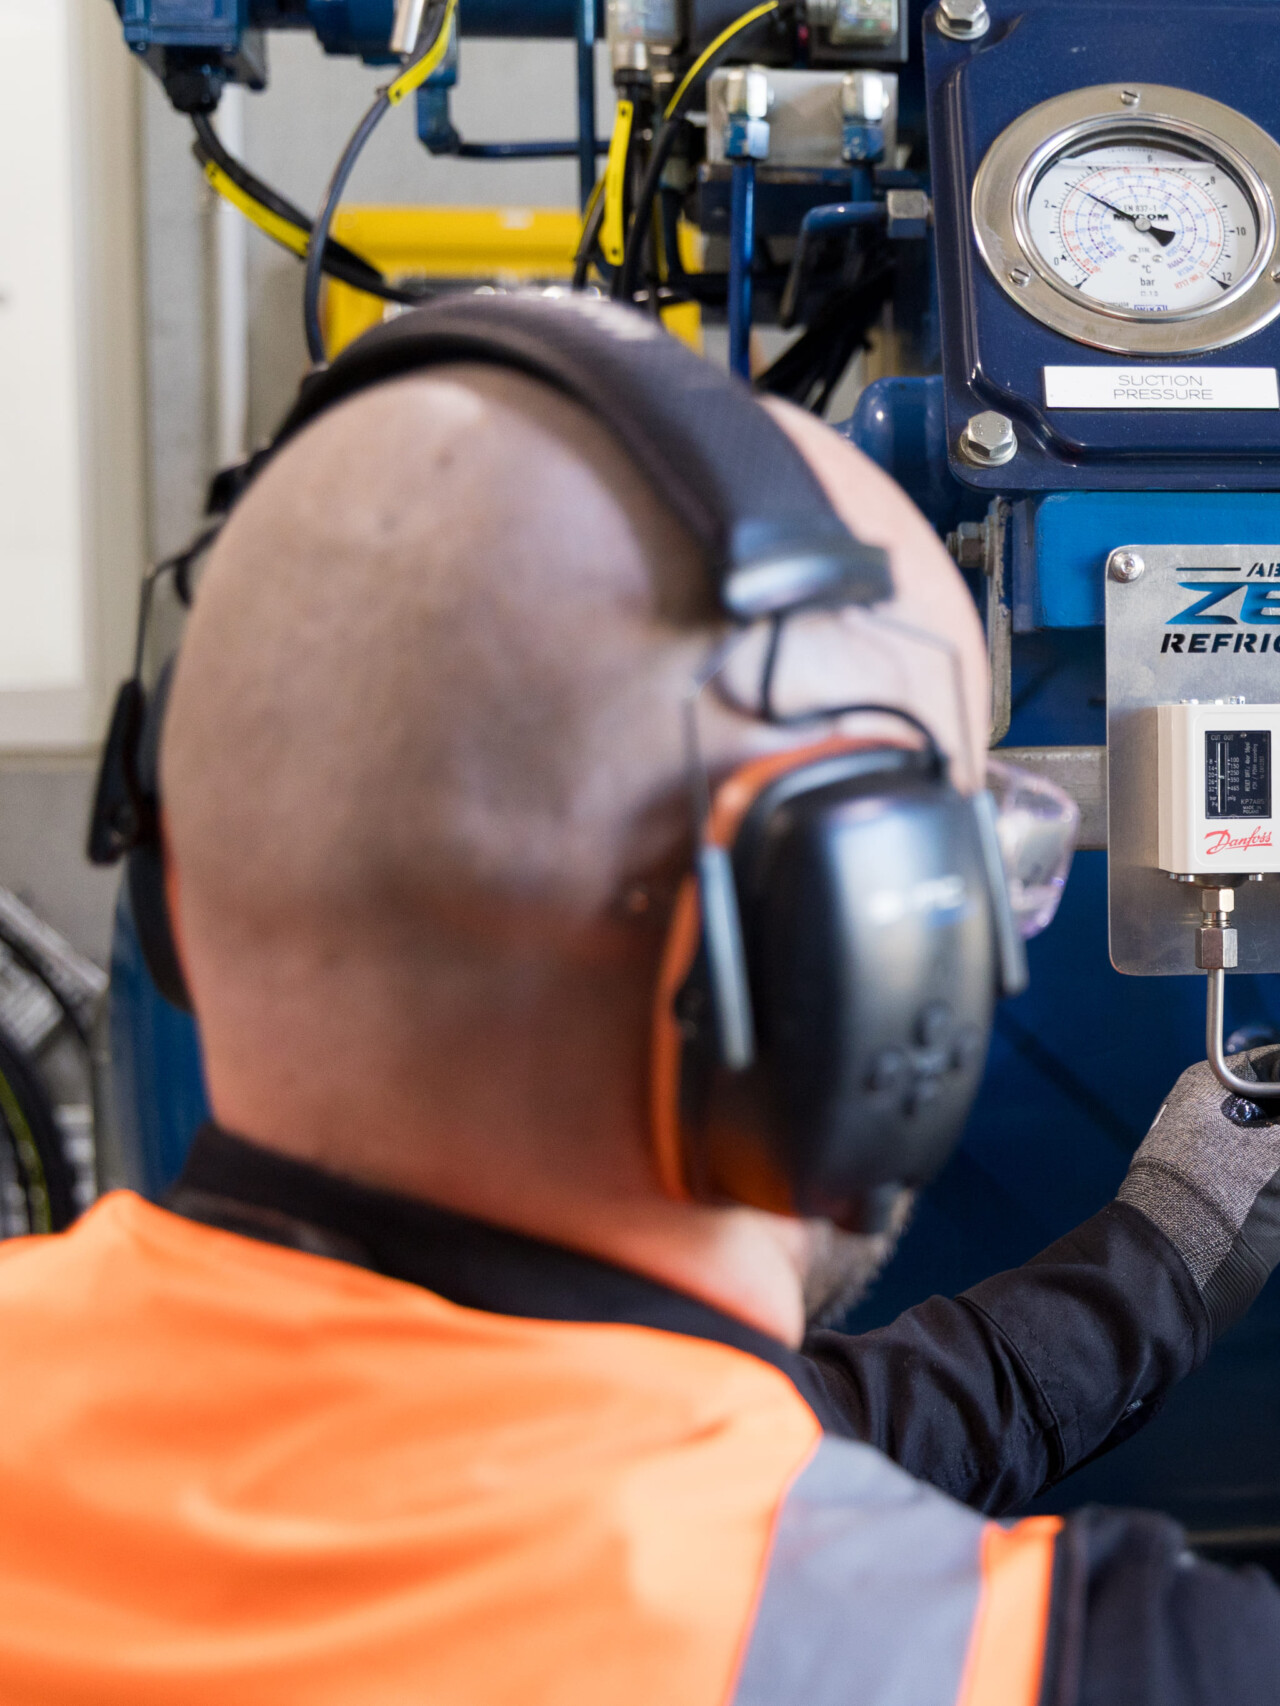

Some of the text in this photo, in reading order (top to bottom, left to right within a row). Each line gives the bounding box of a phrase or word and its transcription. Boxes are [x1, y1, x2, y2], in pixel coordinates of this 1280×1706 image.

[1044, 200, 1050, 208] 2
[1236, 227, 1246, 236] 10
[1222, 272, 1232, 281] 12
[1140, 277, 1155, 287] bar
[1118, 374, 1203, 386] SUCTION
[1113, 388, 1213, 400] PRESSURE
[1204, 825, 1273, 855] Danfoss
